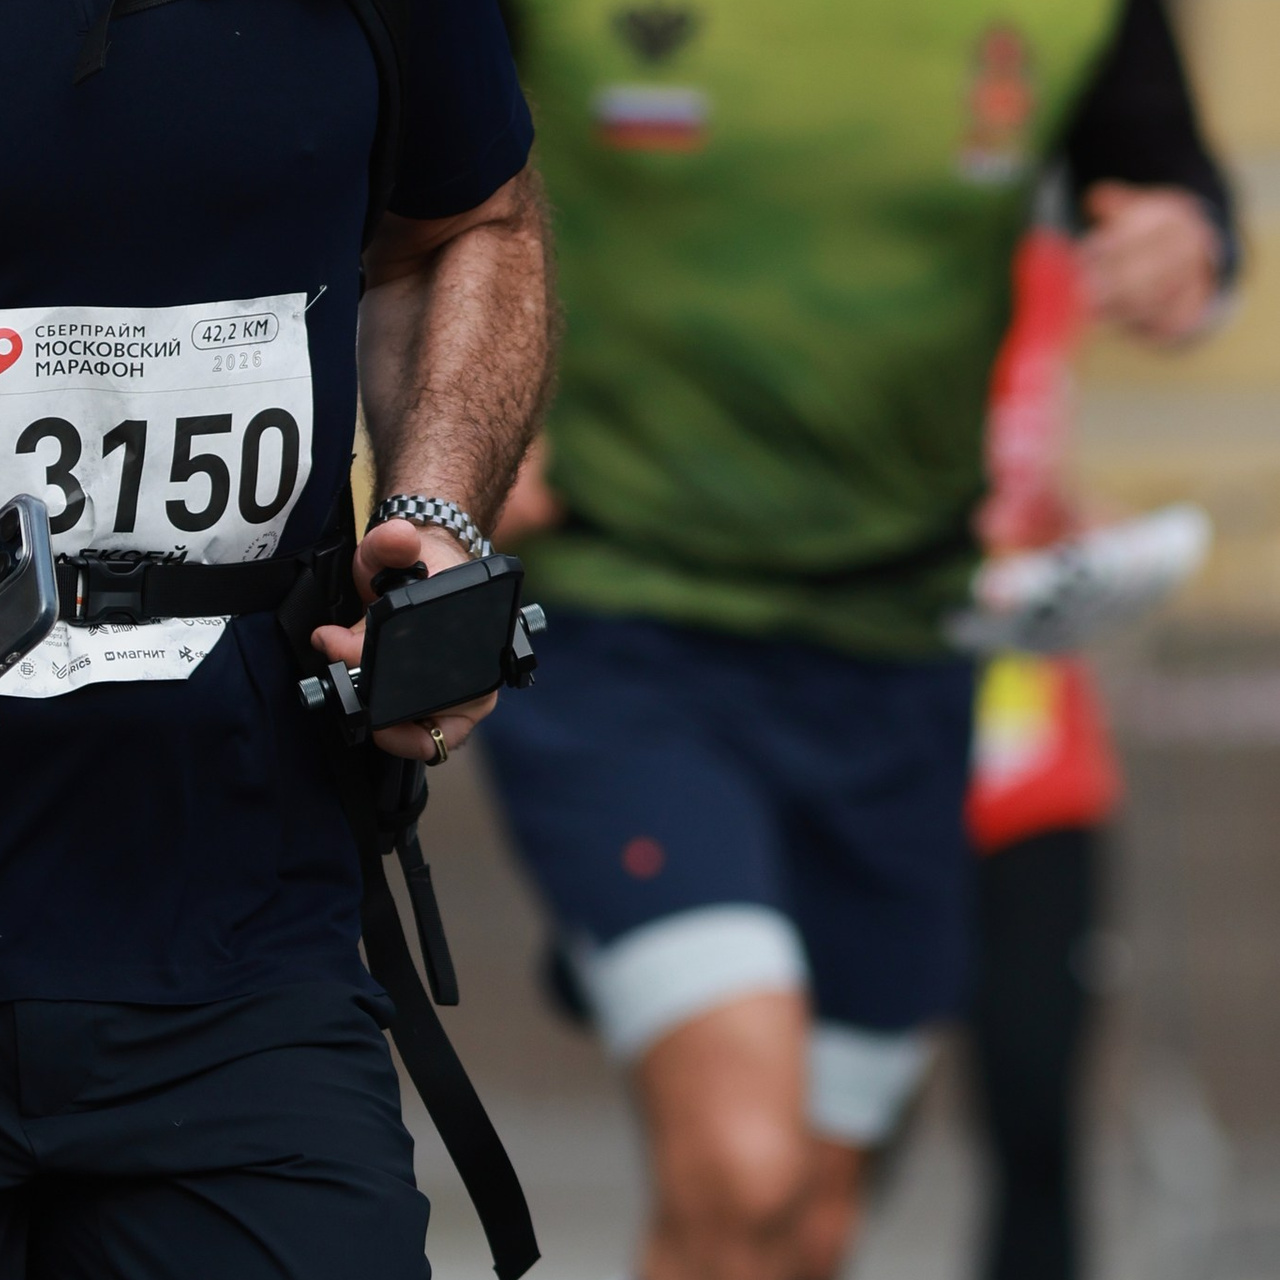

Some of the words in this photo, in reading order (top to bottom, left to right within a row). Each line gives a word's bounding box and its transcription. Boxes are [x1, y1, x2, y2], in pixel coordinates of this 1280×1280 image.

[35, 323, 146, 338] СБЕРПРАЙМ
[202, 323, 237, 344] 42,2
[35, 338, 181, 358] МОСКОВСКИЙ
[35, 359, 144, 378] МАРАФОН
[212, 350, 262, 373] 2026
